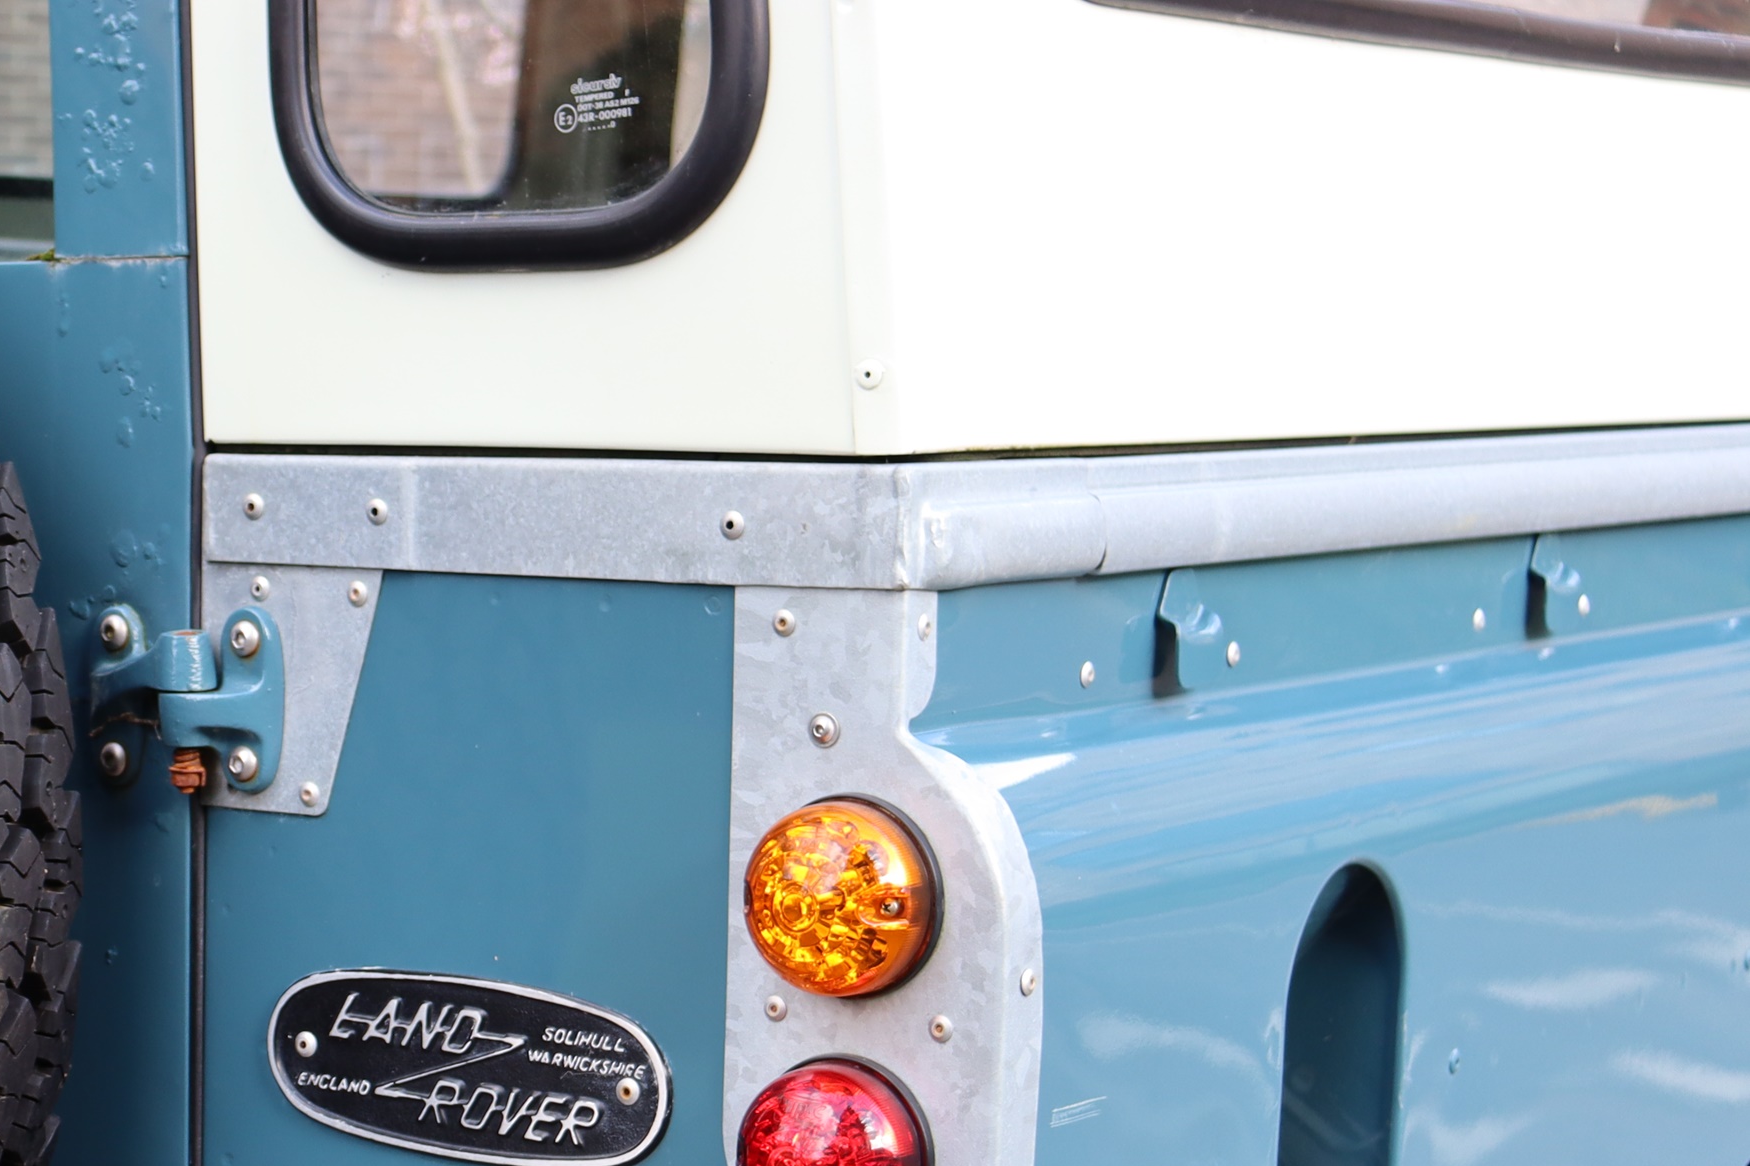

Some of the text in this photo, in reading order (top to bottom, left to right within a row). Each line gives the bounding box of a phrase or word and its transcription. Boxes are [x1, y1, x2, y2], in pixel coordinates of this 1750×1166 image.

[574, 91, 615, 103] TEMPERED
[604, 98, 619, 108] AS2
[558, 112, 573, 126] E2
[578, 107, 632, 123] 43R-000981
[329, 991, 485, 1055] LAND
[541, 1025, 626, 1054] SOLIHULL
[528, 1048, 648, 1080] WARWICKSHIRE
[296, 1072, 371, 1096] ENGLAND
[418, 1078, 602, 1147] ROVER
